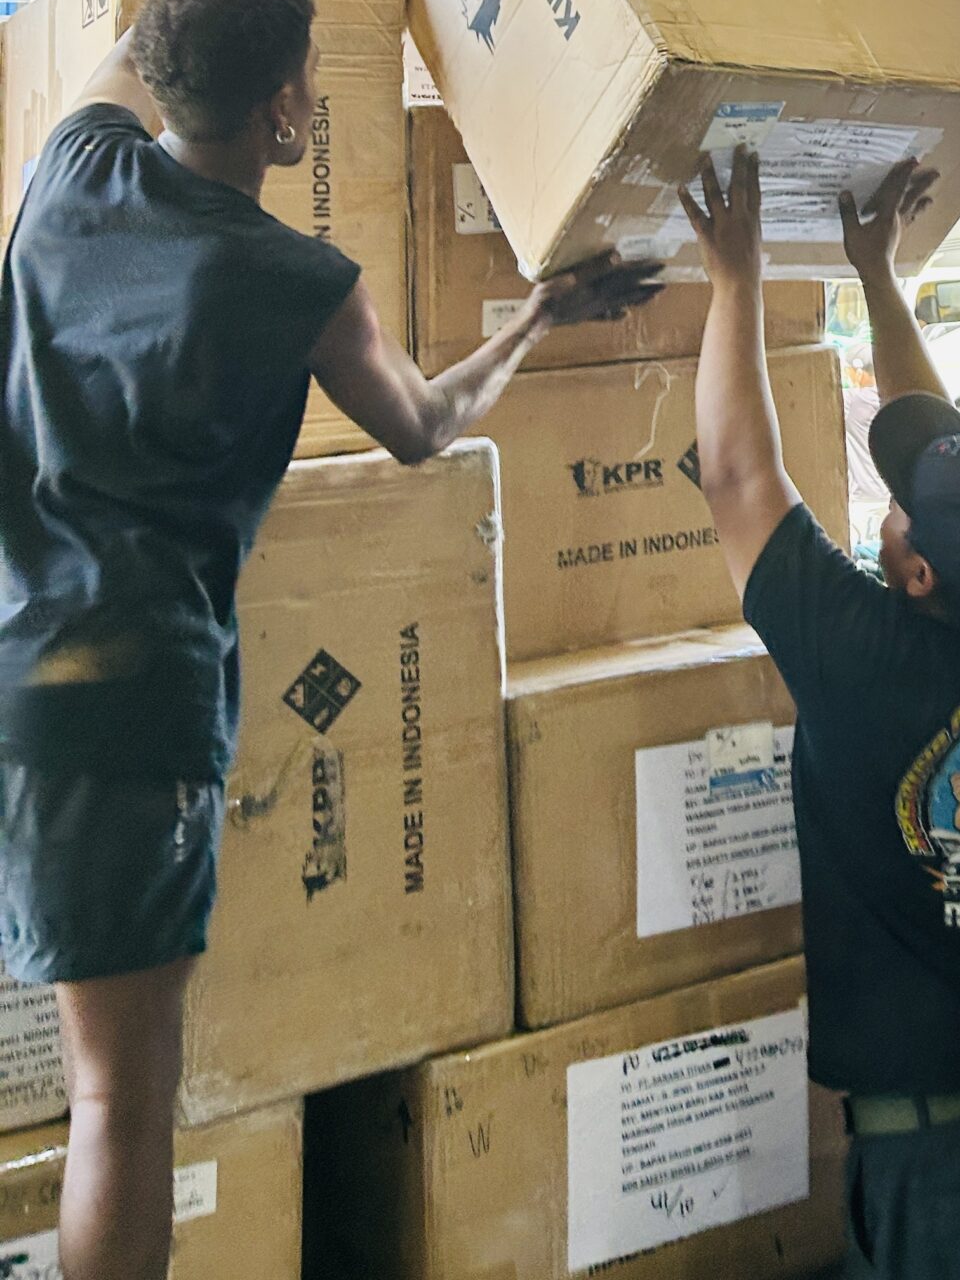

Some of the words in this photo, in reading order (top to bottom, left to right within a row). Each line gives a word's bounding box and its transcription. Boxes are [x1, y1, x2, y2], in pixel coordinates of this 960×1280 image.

[313, 95, 331, 218] INDONESIA
[602, 459, 664, 486] KPR
[557, 543, 613, 569] MADE
[619, 538, 637, 558] IN
[643, 528, 720, 554] INDONE
[401, 622, 422, 772] INDONESIA
[403, 777, 423, 802] IN
[403, 809, 425, 895] MADE
